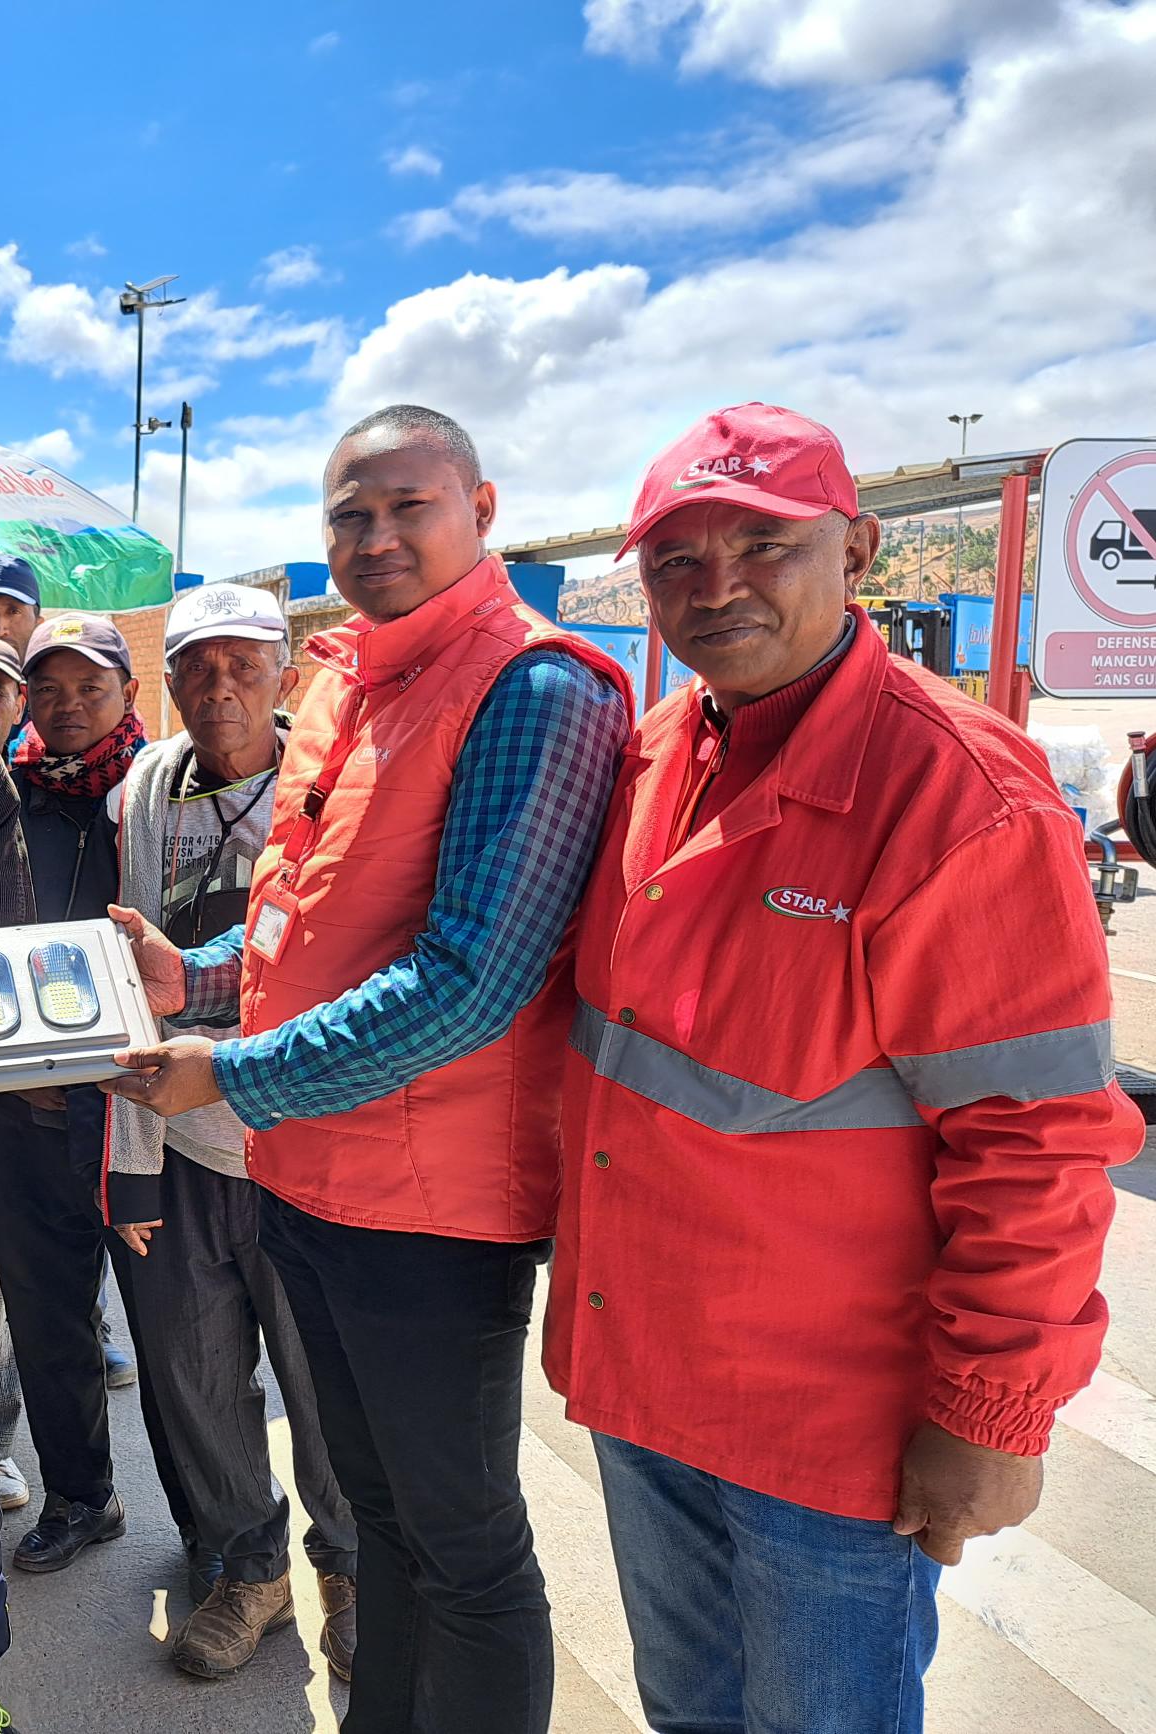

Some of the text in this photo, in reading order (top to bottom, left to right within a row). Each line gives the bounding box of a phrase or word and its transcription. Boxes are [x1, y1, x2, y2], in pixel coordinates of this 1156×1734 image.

[688, 456, 743, 477] STAR
[1097, 636, 1156, 649] DEFENSE
[1095, 673, 1156, 686] SANS GU
[164, 836, 194, 846] ECTOR
[780, 890, 827, 914] STAR
